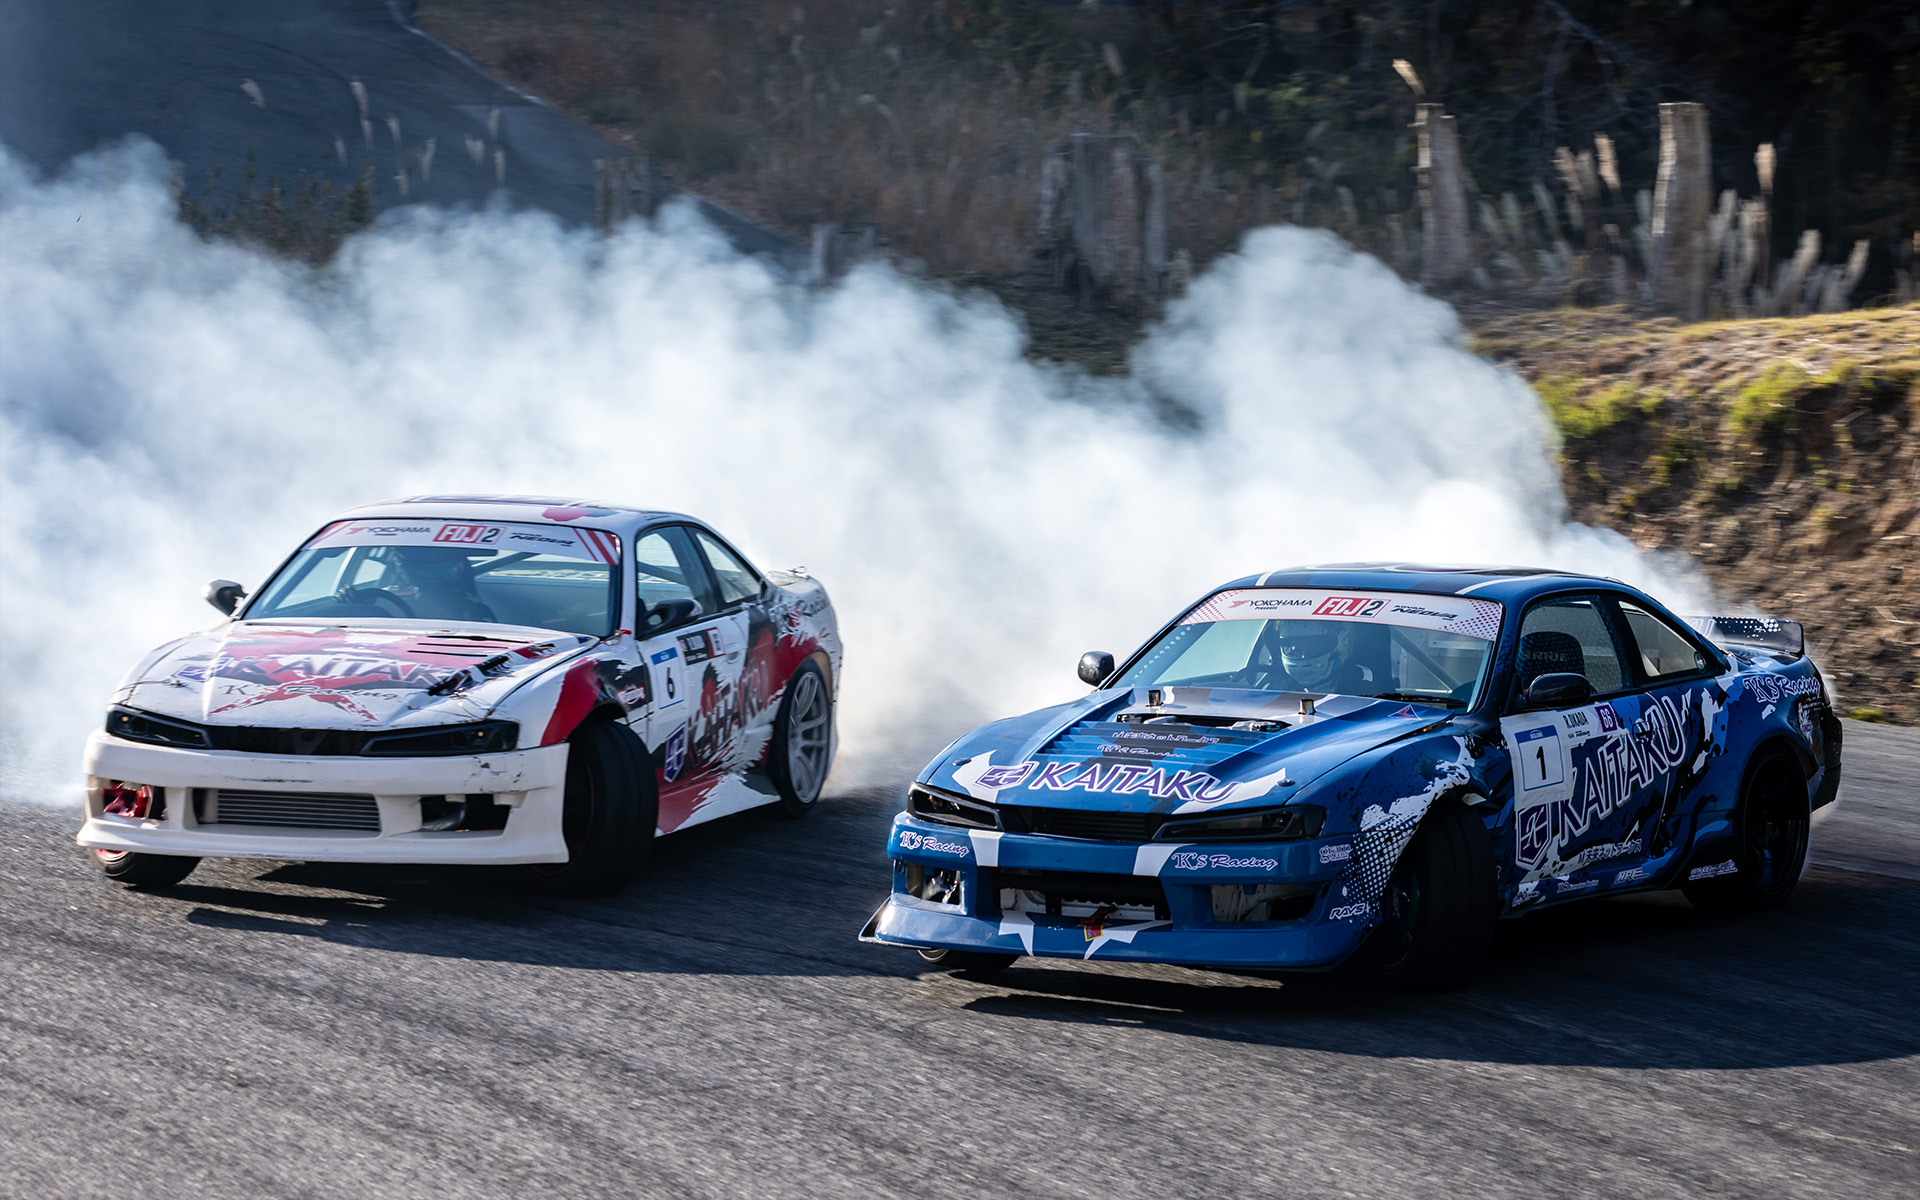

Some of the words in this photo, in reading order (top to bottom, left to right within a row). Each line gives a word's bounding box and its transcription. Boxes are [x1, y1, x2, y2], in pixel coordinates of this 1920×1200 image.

[1249, 599, 1313, 607] YOKOHAMA
[666, 667, 676, 699] 6
[1774, 674, 1821, 698] Racing
[1600, 708, 1614, 729] 66
[1536, 745, 1547, 781] 1
[1029, 761, 1242, 803] KAITAKU
[922, 836, 969, 858] Racing
[1209, 855, 1278, 871] Racing
[1329, 904, 1366, 920] RAYS
